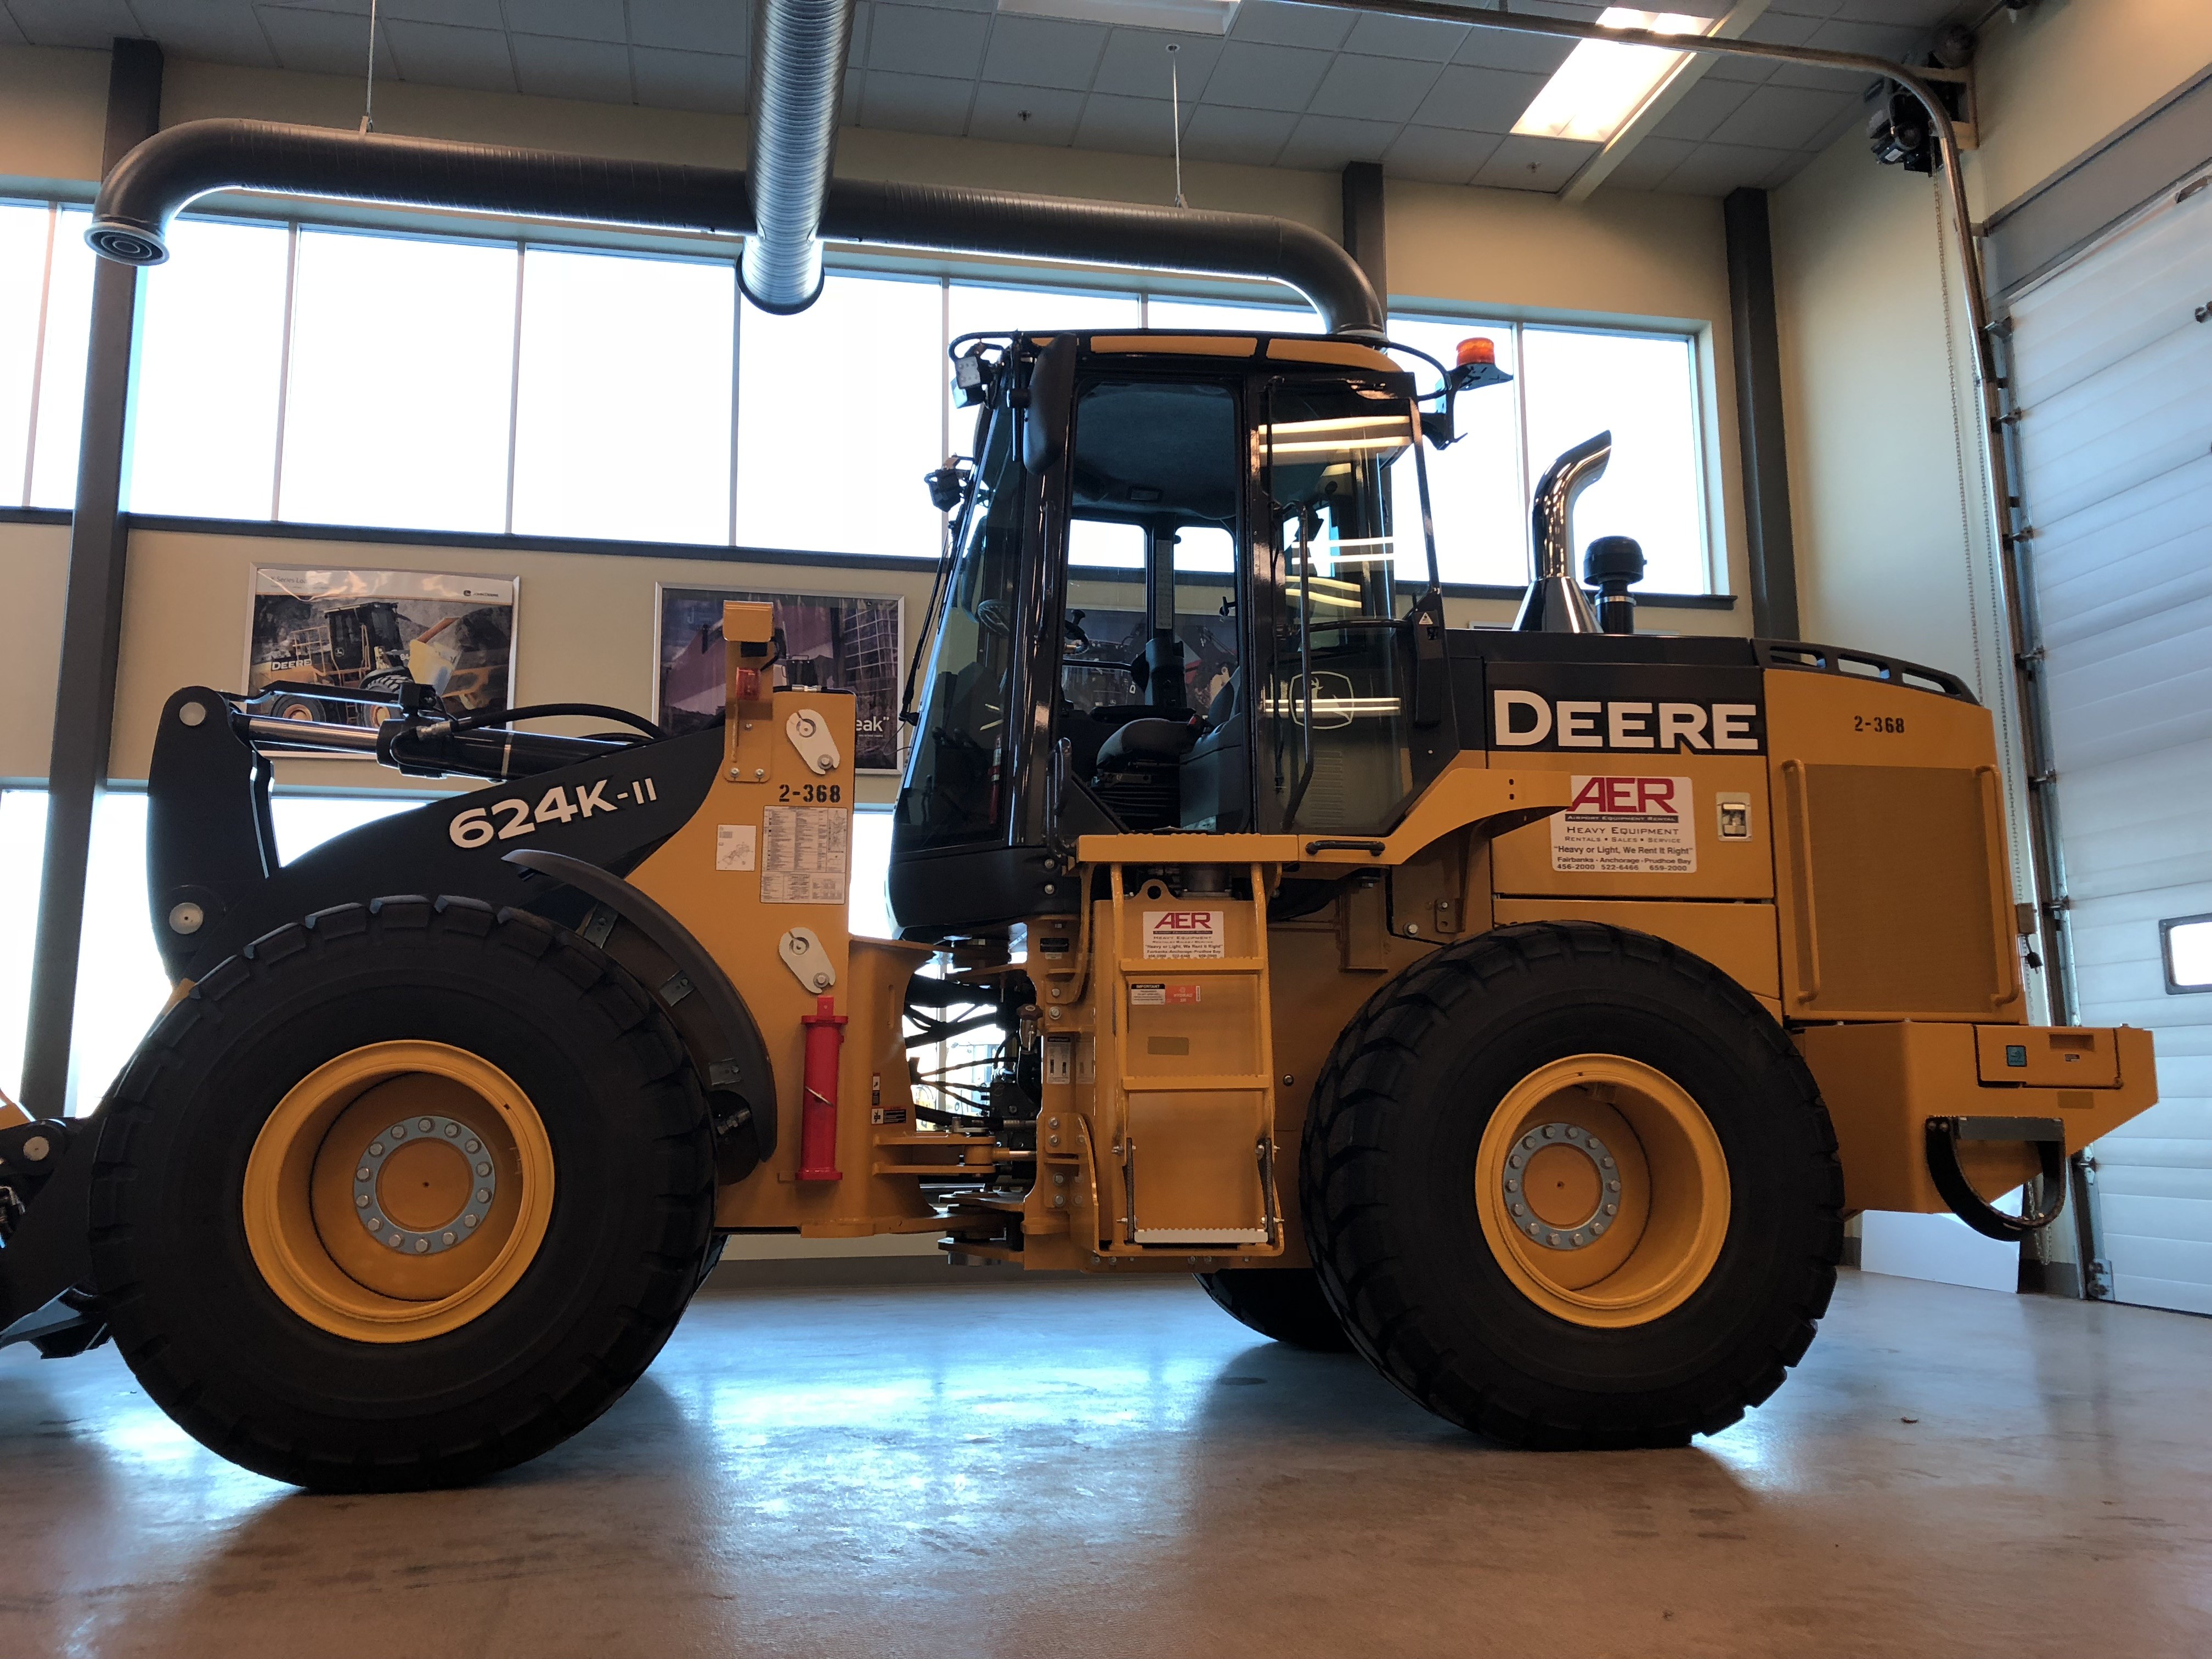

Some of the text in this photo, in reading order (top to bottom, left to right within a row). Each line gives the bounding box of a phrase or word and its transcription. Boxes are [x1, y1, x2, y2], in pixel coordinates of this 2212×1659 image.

[272, 659, 312, 670] DEERE
[1494, 690, 1758, 750] DEERE
[1854, 715, 1905, 733] 2-368
[778, 784, 841, 803] 2-368
[1565, 776, 1678, 814] AER
[449, 777, 657, 849] 624K-II
[1597, 847, 1621, 855] Light,
[1154, 912, 1212, 929] AER
